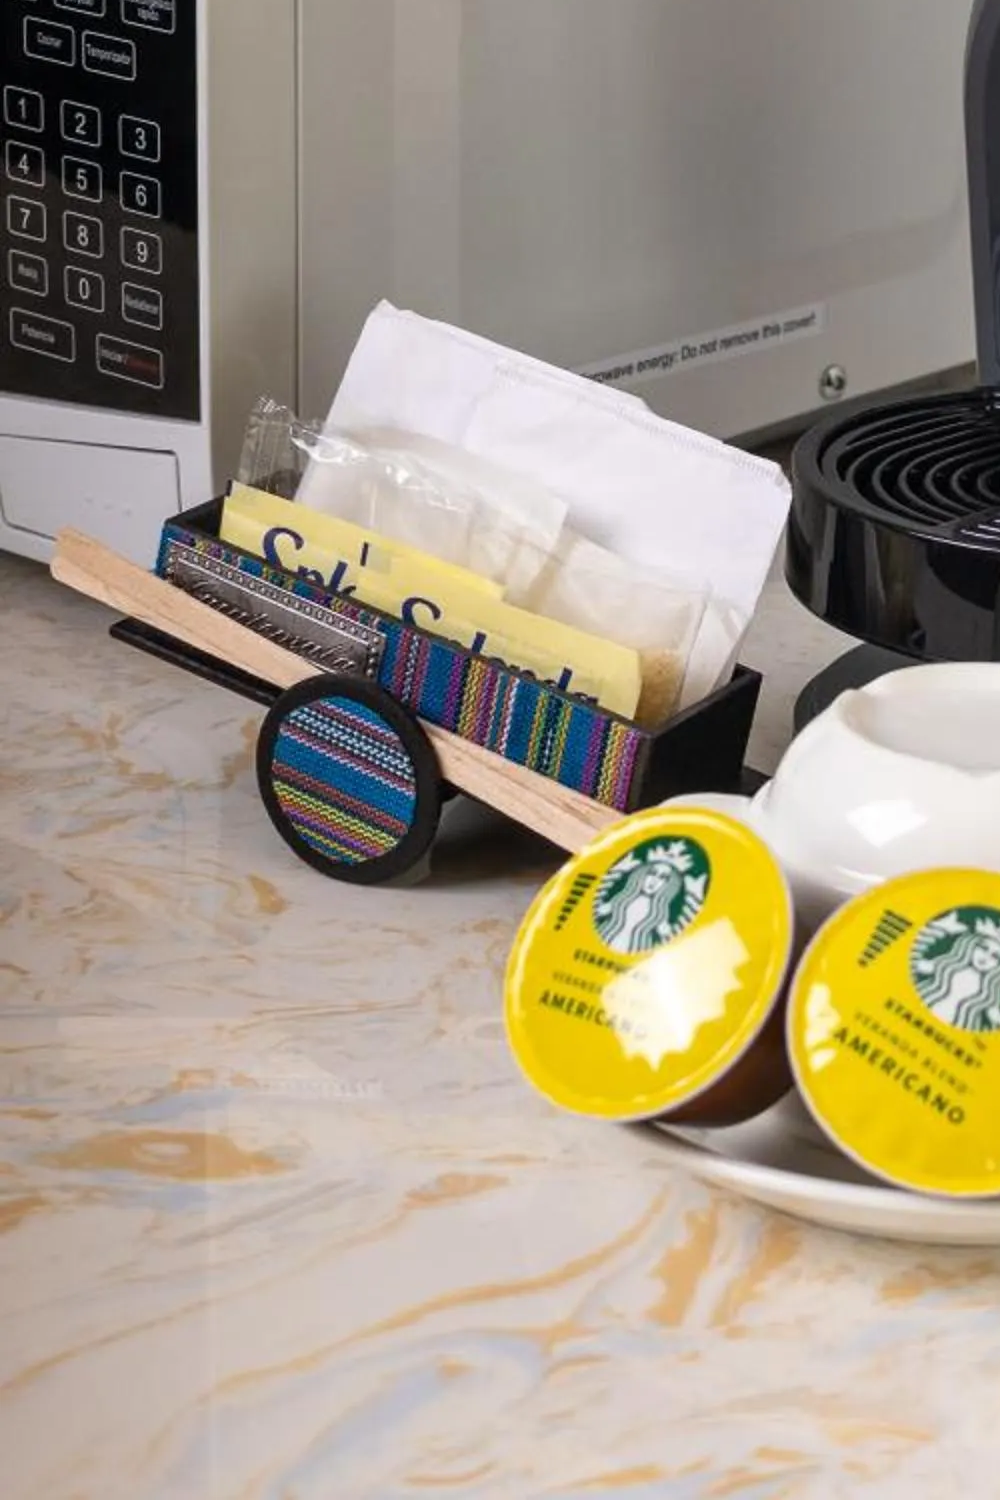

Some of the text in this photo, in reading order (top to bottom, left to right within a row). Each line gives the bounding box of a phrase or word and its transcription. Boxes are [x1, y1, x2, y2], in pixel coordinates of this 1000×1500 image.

[17, 97, 147, 150] 1 2 3
[17, 153, 147, 206] 4 5 6
[19, 207, 148, 263] 7 8 9
[78, 277, 90, 300] 0
[681, 345, 697, 361] Do
[832, 1026, 966, 1125] AMERICANO
